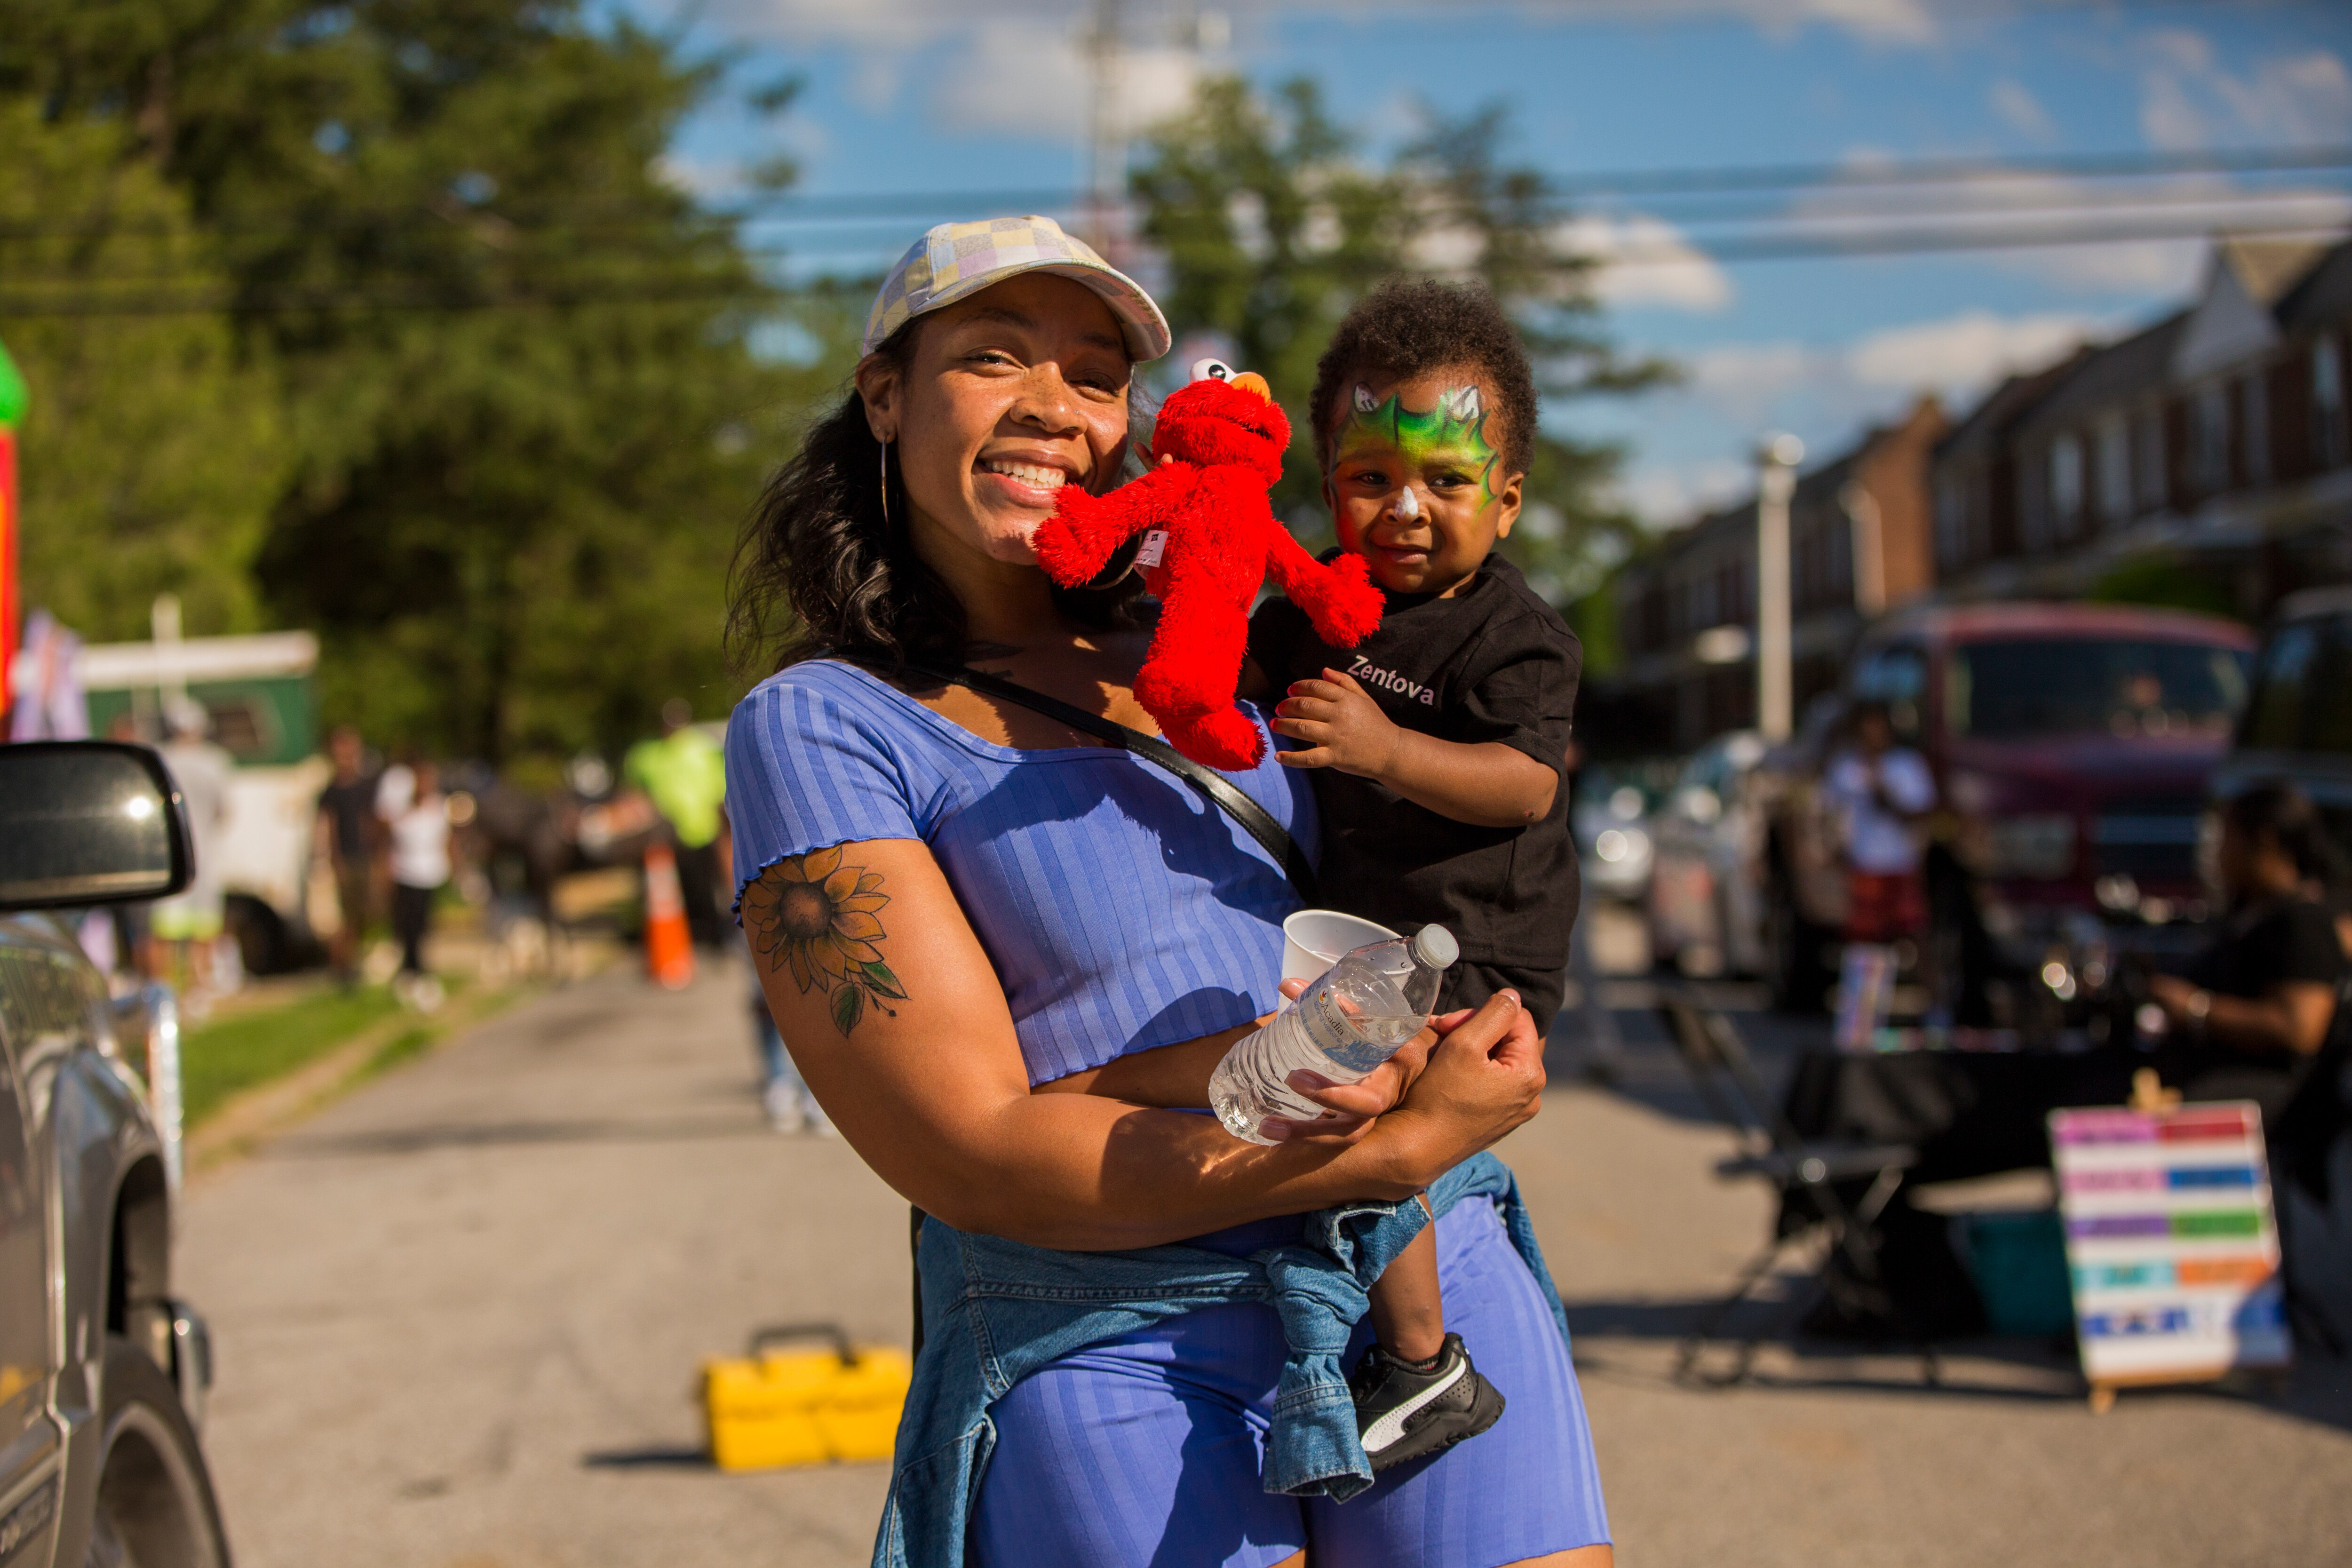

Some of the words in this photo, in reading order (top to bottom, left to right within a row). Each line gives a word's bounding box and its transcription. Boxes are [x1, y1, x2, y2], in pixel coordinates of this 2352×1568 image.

[1347, 654, 1434, 705] Zentova
[1314, 1001, 1324, 1022] spring
[1323, 1022, 1339, 1038] water
[1321, 1004, 1344, 1035] Acadia
